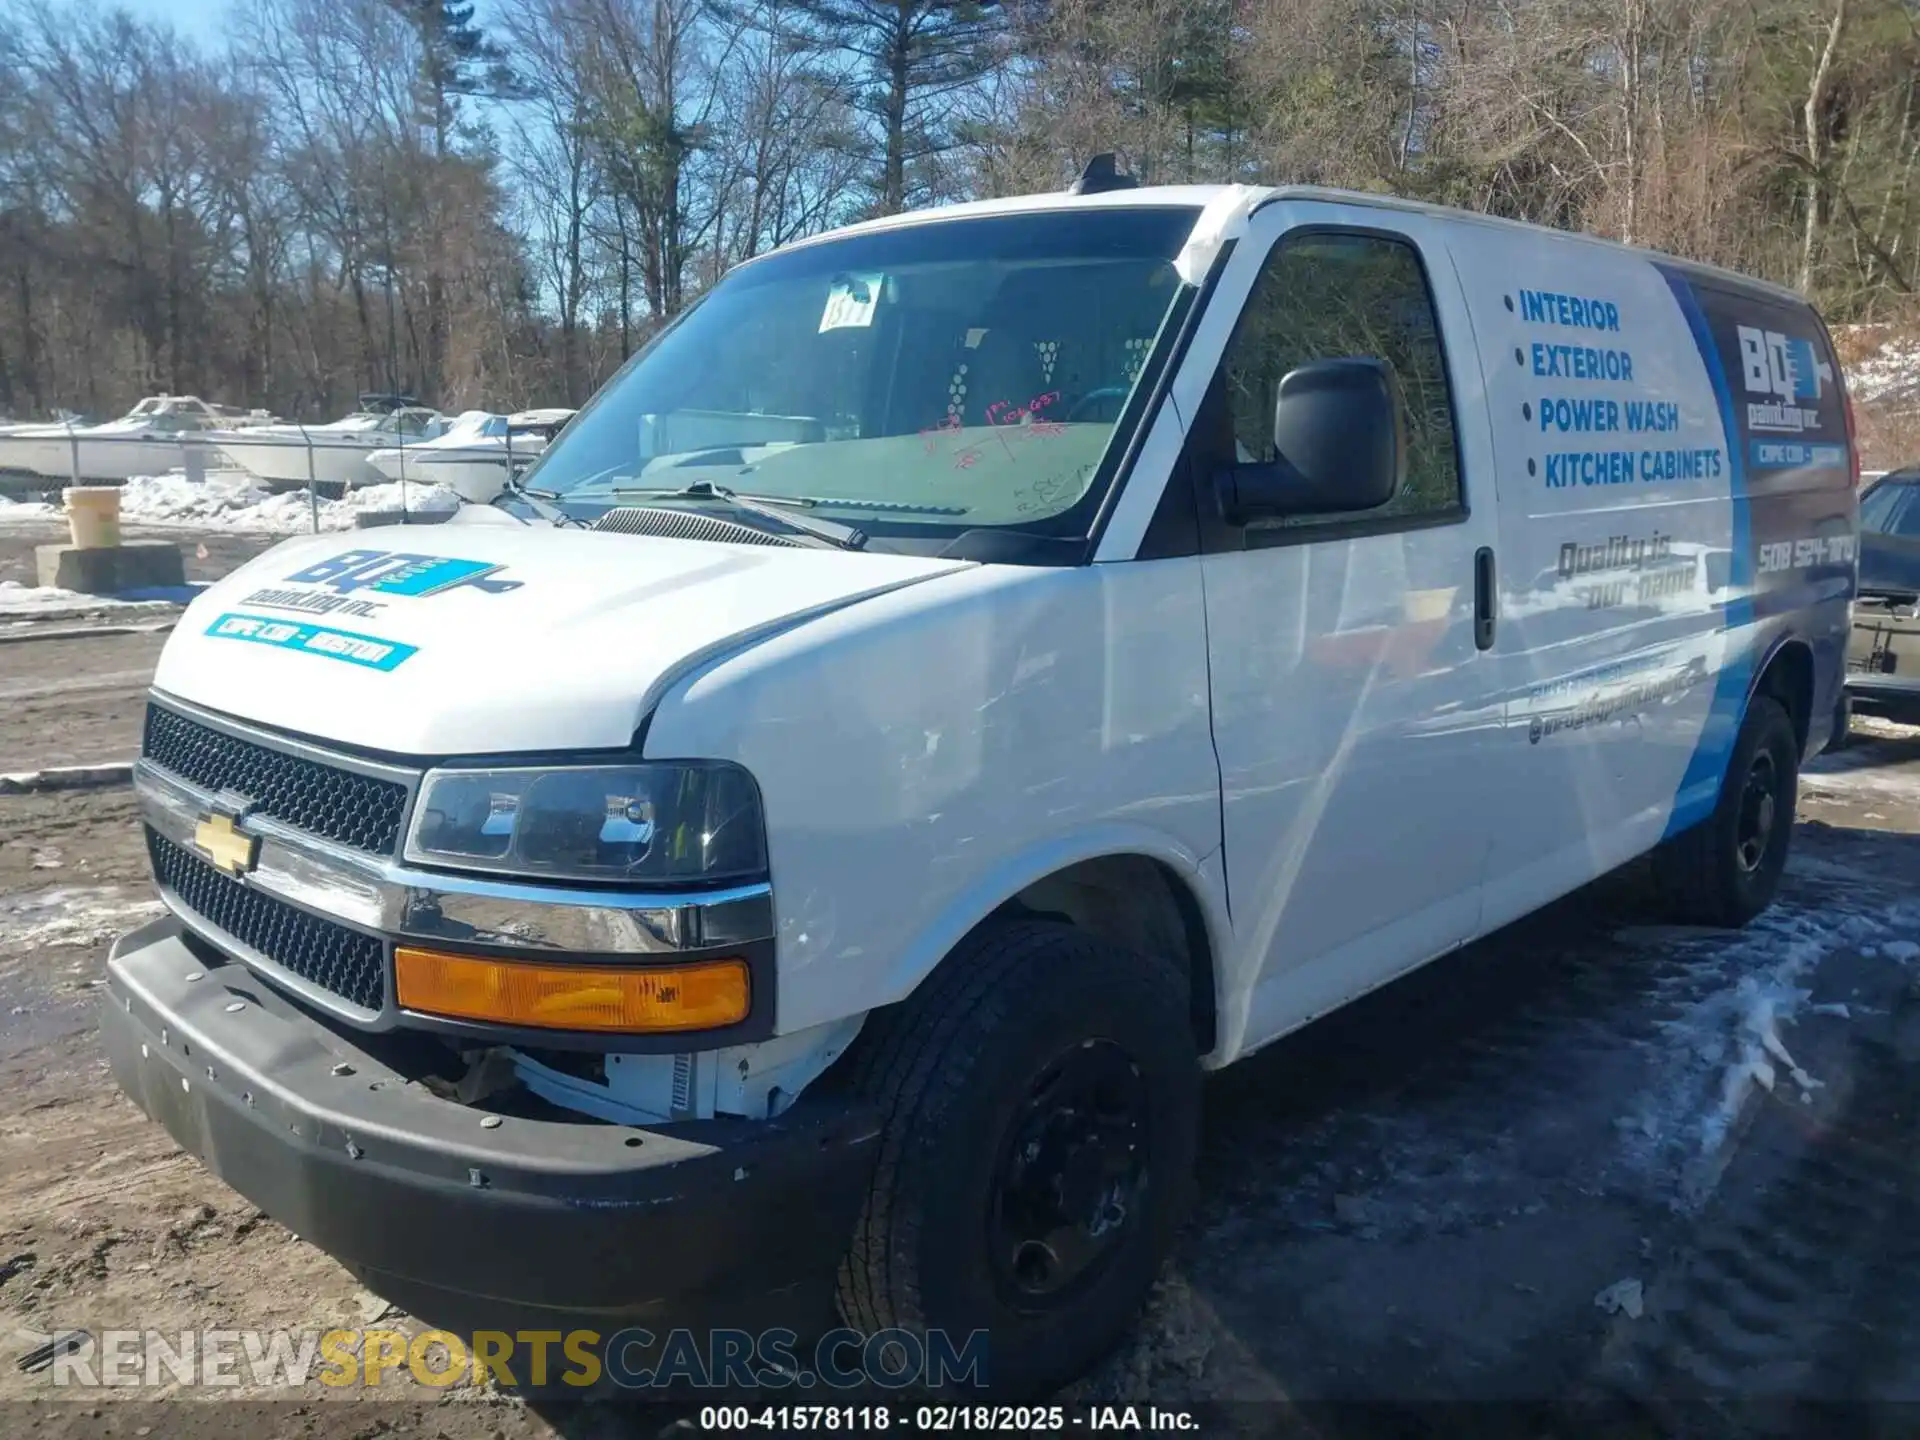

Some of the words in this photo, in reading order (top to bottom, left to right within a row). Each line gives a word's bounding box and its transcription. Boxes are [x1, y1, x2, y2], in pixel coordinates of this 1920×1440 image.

[1519, 289, 1620, 332] INTERIOR
[1532, 343, 1633, 381] EXTERIOR
[1540, 399, 1619, 432] POWER
[1624, 401, 1679, 432] WASH
[1545, 452, 1635, 488] KITCHEN
[1640, 450, 1721, 482] CABINETS
[1558, 533, 1646, 580] Quality
